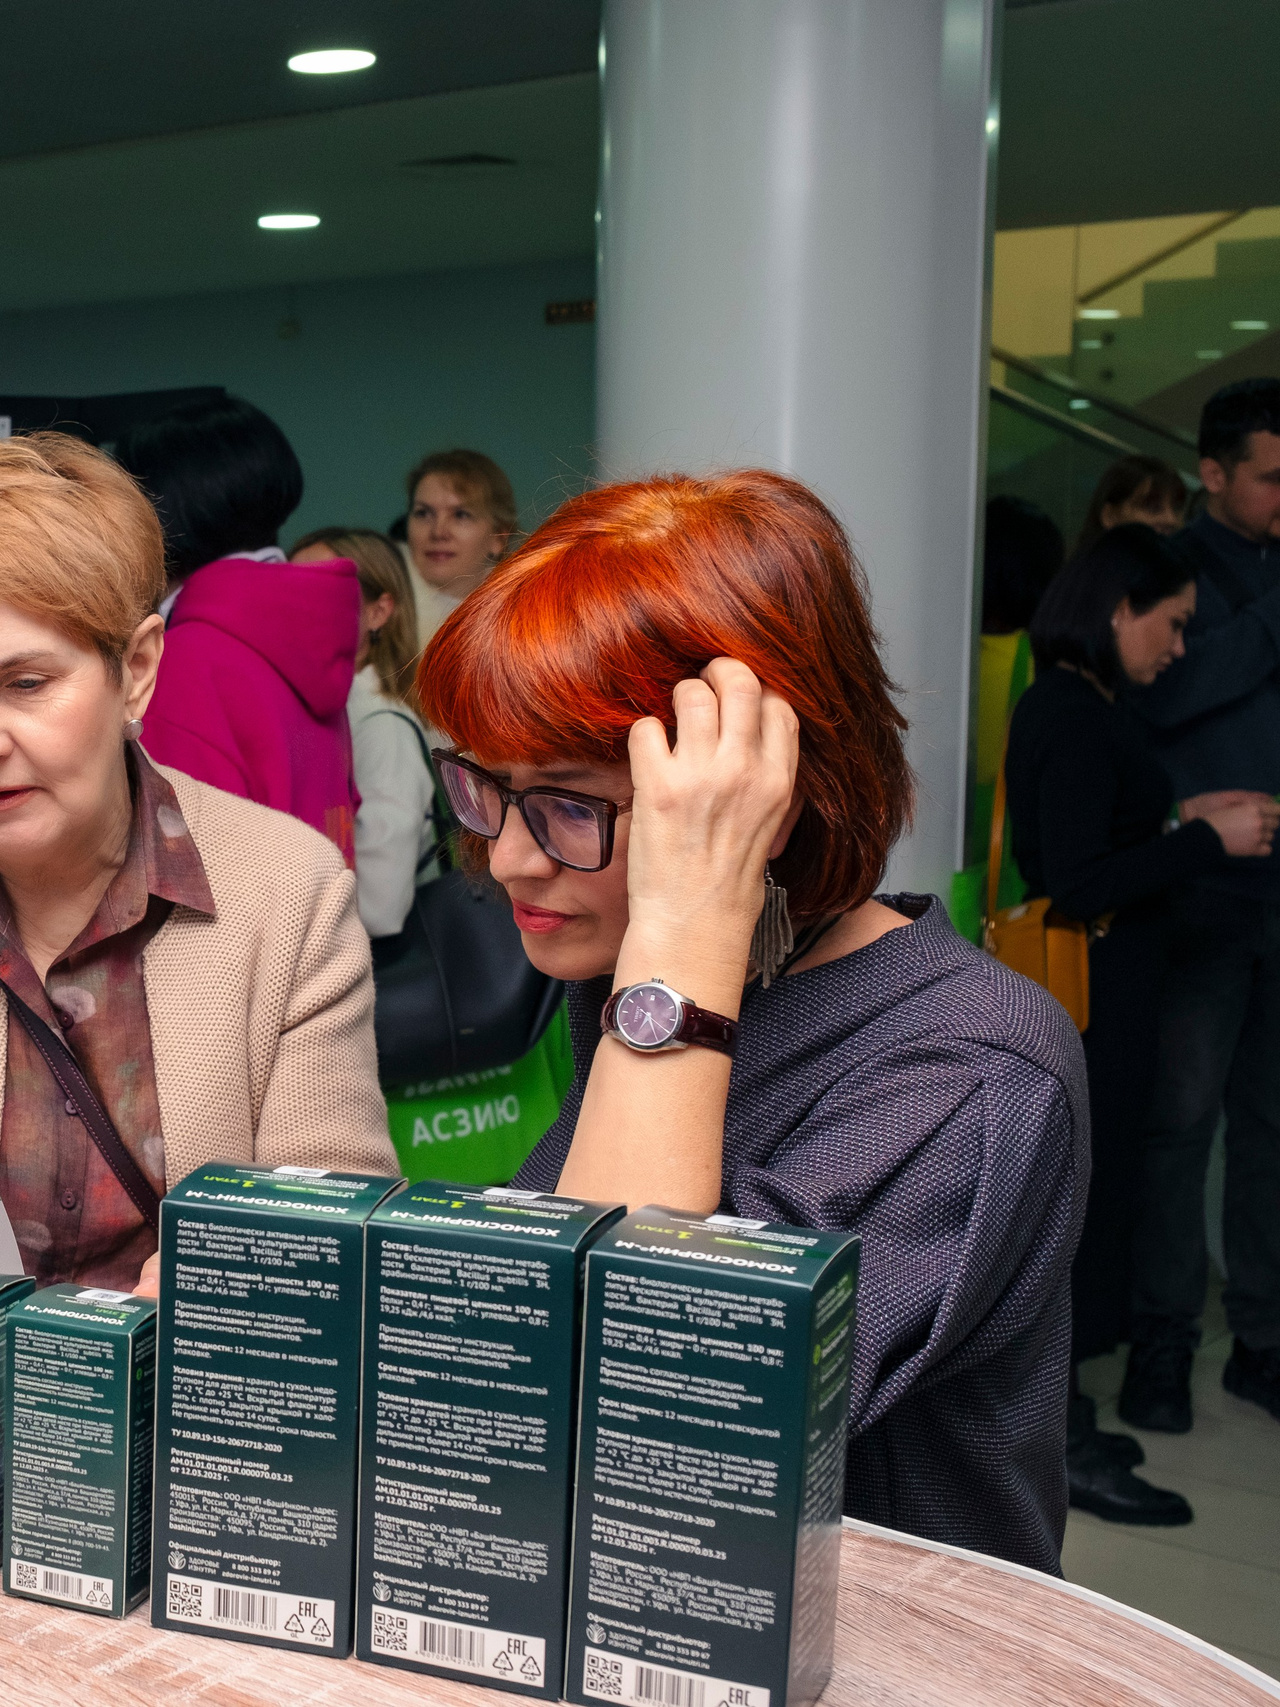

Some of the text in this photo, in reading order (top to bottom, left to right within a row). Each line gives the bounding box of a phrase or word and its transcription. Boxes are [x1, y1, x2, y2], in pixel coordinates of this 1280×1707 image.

[411, 1094, 520, 1148] АСЗИЮ
[204, 1176, 256, 1188] 1 ЭТАП
[411, 1196, 466, 1209] 1 ЭТАП
[177, 1218, 340, 1245] Состав: биологически активные метабо-
[177, 1229, 340, 1255] литы бесклеточной культуральной жид-
[635, 1224, 693, 1240] 1 ЭТАП
[176, 1238, 199, 1246] кости
[205, 1240, 244, 1253] бактерий
[250, 1245, 283, 1256] Bacillus
[288, 1250, 320, 1261] subtilis
[175, 1262, 338, 1290] Показатели пищевой ценности 100 мл:
[174, 1299, 306, 1325] Применять согласно инструкции.
[174, 1308, 322, 1336] Противопоказания: индивидуальная
[174, 1318, 302, 1341] непереносимость компонентов.
[173, 1336, 193, 1348] Срок
[193, 1340, 233, 1353] годности:
[245, 1347, 280, 1359] месяцев
[288, 1352, 337, 1367] невскрытой
[173, 1347, 211, 1359] упаковке.
[183, 1412, 223, 1425] применять
[235, 1419, 275, 1431] истечении
[275, 1425, 299, 1436] срока
[299, 1428, 336, 1441] годности.
[181, 1429, 282, 1452] 10.89.19-156-20672718-2020
[170, 1447, 269, 1471] Регистрационный номер
[170, 1456, 293, 1482] AM.01.01.01.003.R.000070.03.25
[181, 1466, 222, 1480] 12.03.2025
[169, 1483, 222, 1498] Изготовитель:
[223, 1491, 240, 1501] ООО
[312, 1506, 337, 1517] адрес:
[168, 1521, 216, 1536] bashinkom.ru
[168, 1540, 281, 1567] Официальный дистрибьютор:
